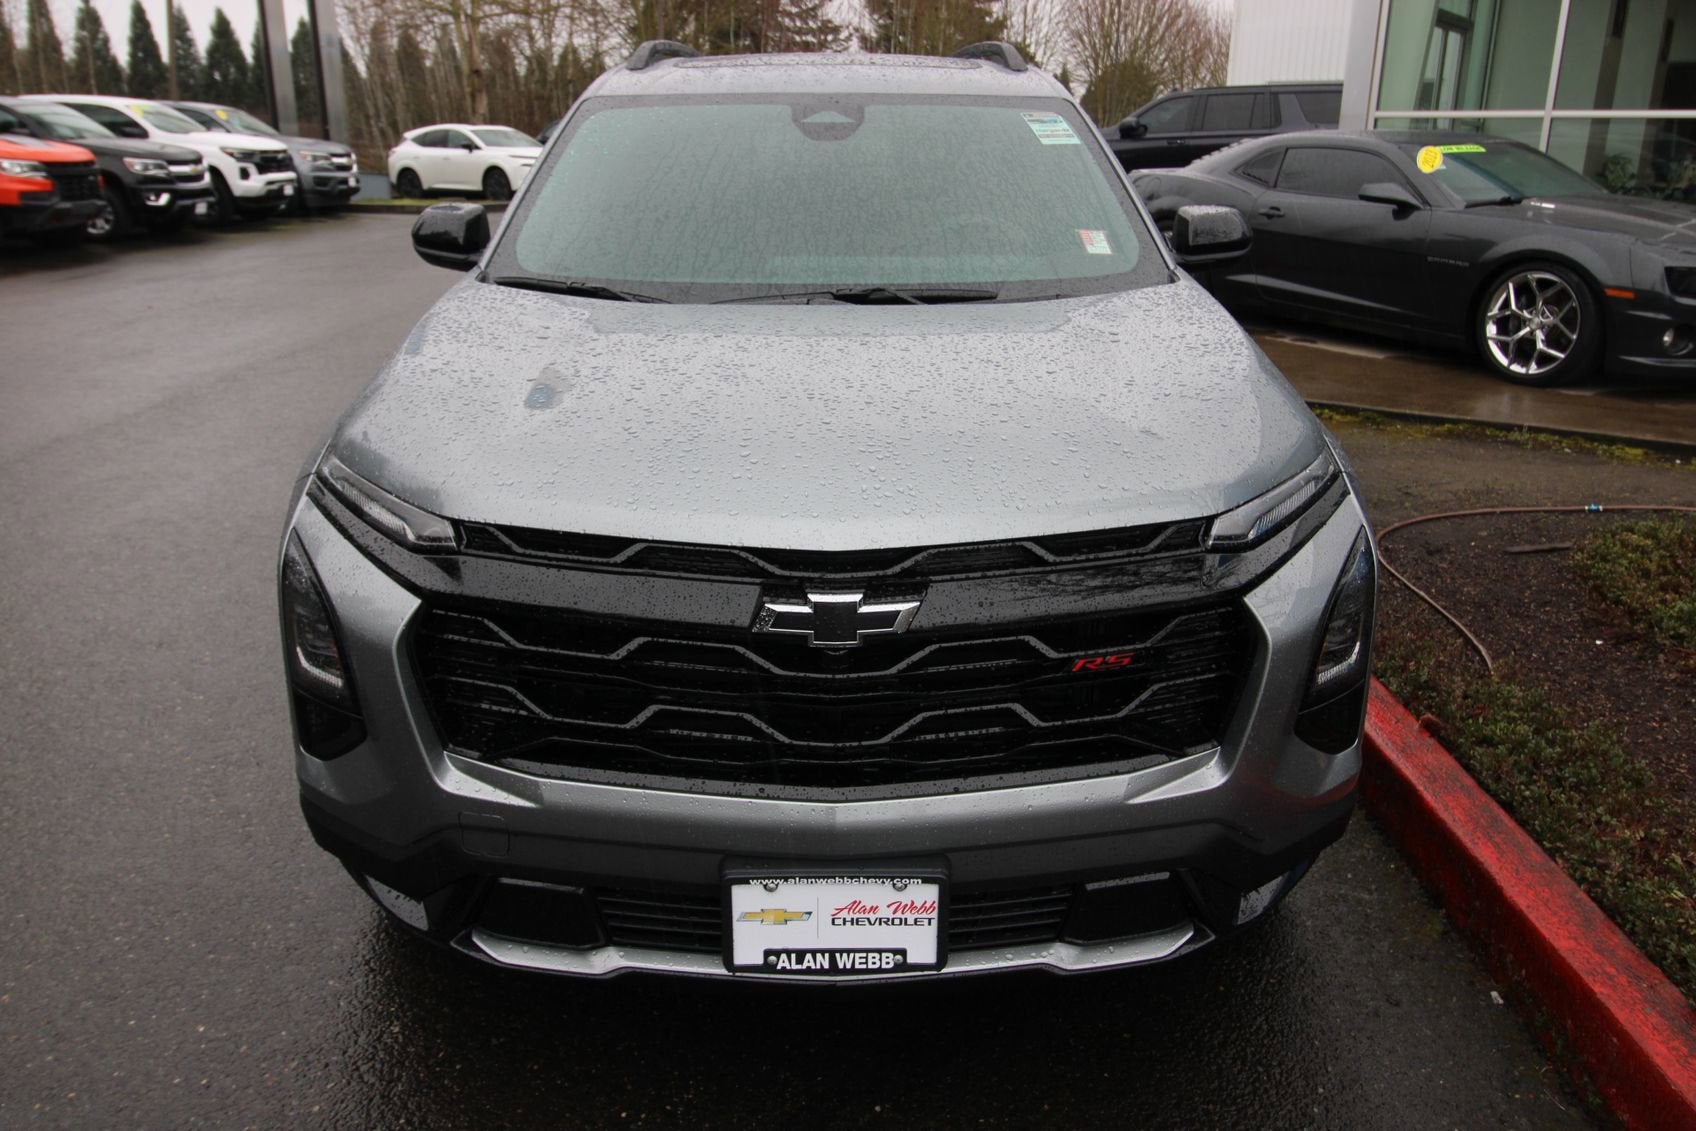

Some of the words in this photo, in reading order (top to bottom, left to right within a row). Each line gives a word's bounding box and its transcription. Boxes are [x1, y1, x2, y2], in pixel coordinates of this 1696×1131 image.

[1072, 652, 1134, 673] RS
[749, 876, 922, 885] www.alanwebbchevy.com
[831, 900, 880, 917] Alan
[887, 900, 936, 916] Webb
[831, 917, 936, 926] CHEVROLET
[776, 953, 830, 970] ALAN
[837, 952, 895, 969] WEBB
